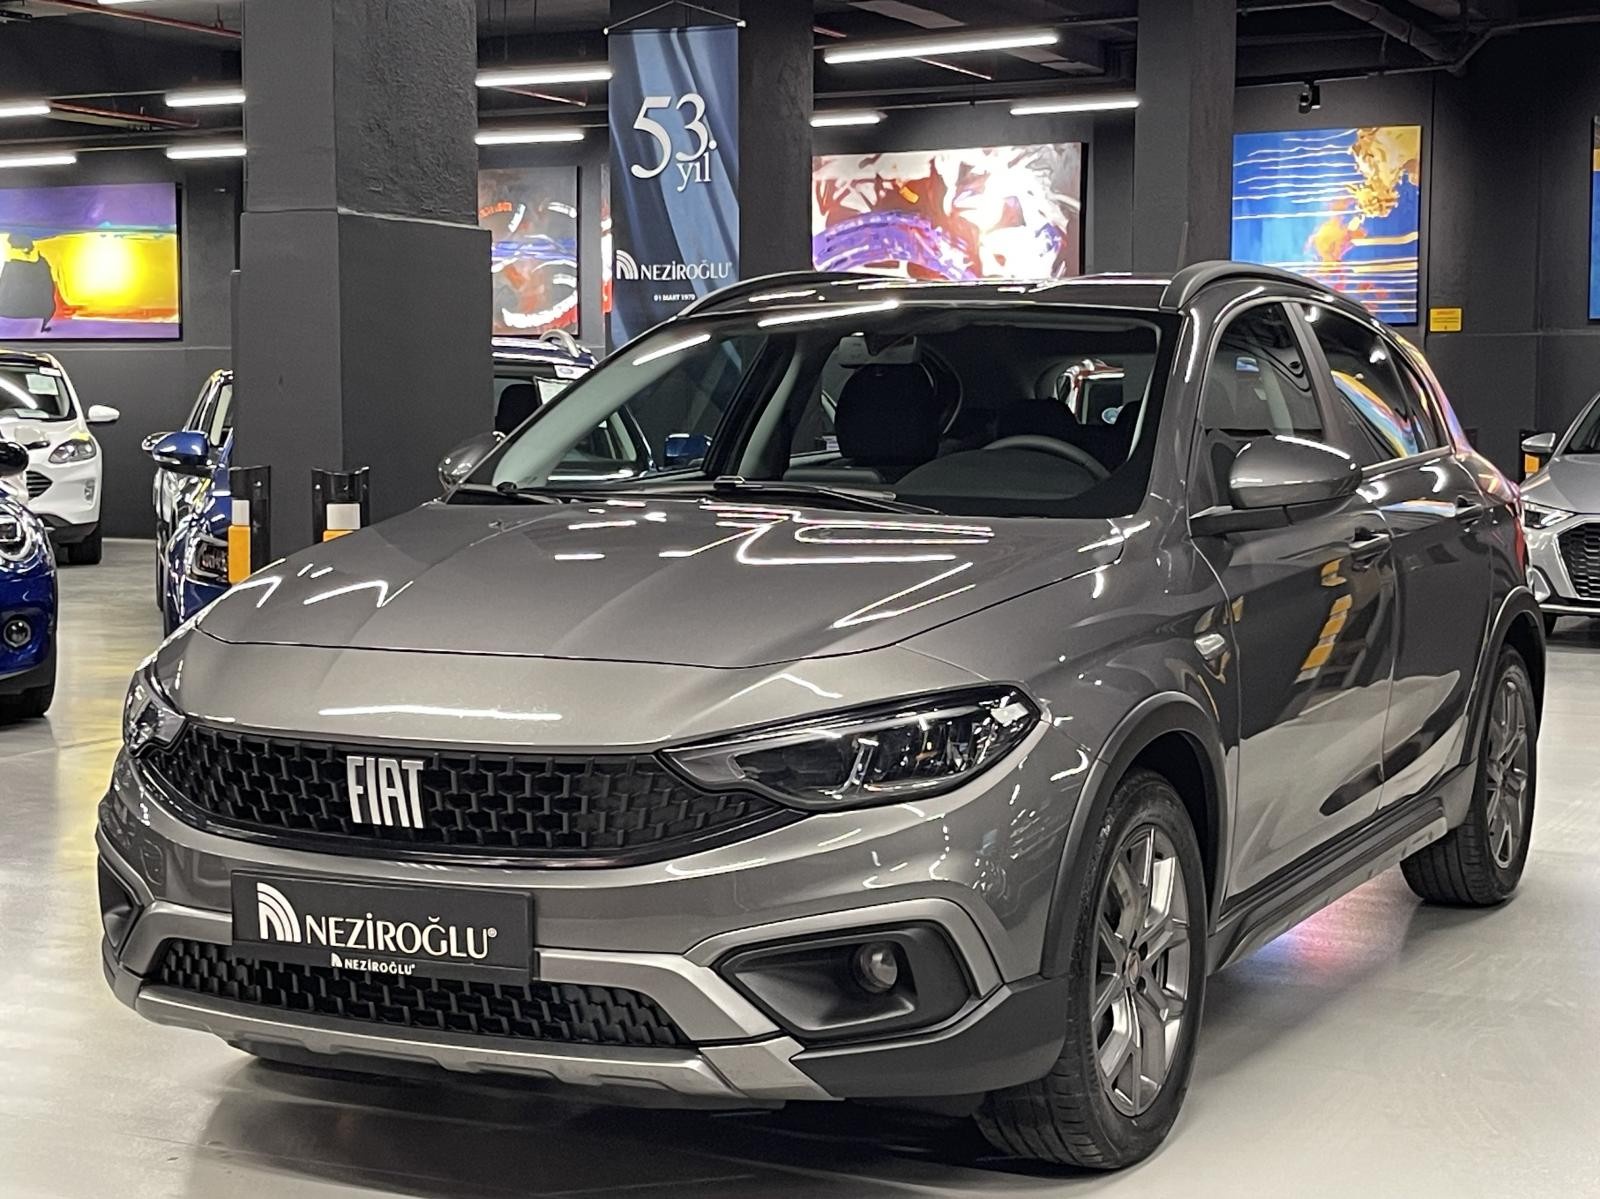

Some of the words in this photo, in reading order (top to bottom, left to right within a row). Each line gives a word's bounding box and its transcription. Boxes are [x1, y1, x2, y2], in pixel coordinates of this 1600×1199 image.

[631, 93, 717, 179] 53.
[676, 152, 711, 192] yıl
[640, 260, 729, 280] NEZİROĞLU
[346, 755, 424, 829] FIAT
[305, 912, 489, 959] NEZİROĞLU
[344, 958, 412, 975] NEZİROĞLU
